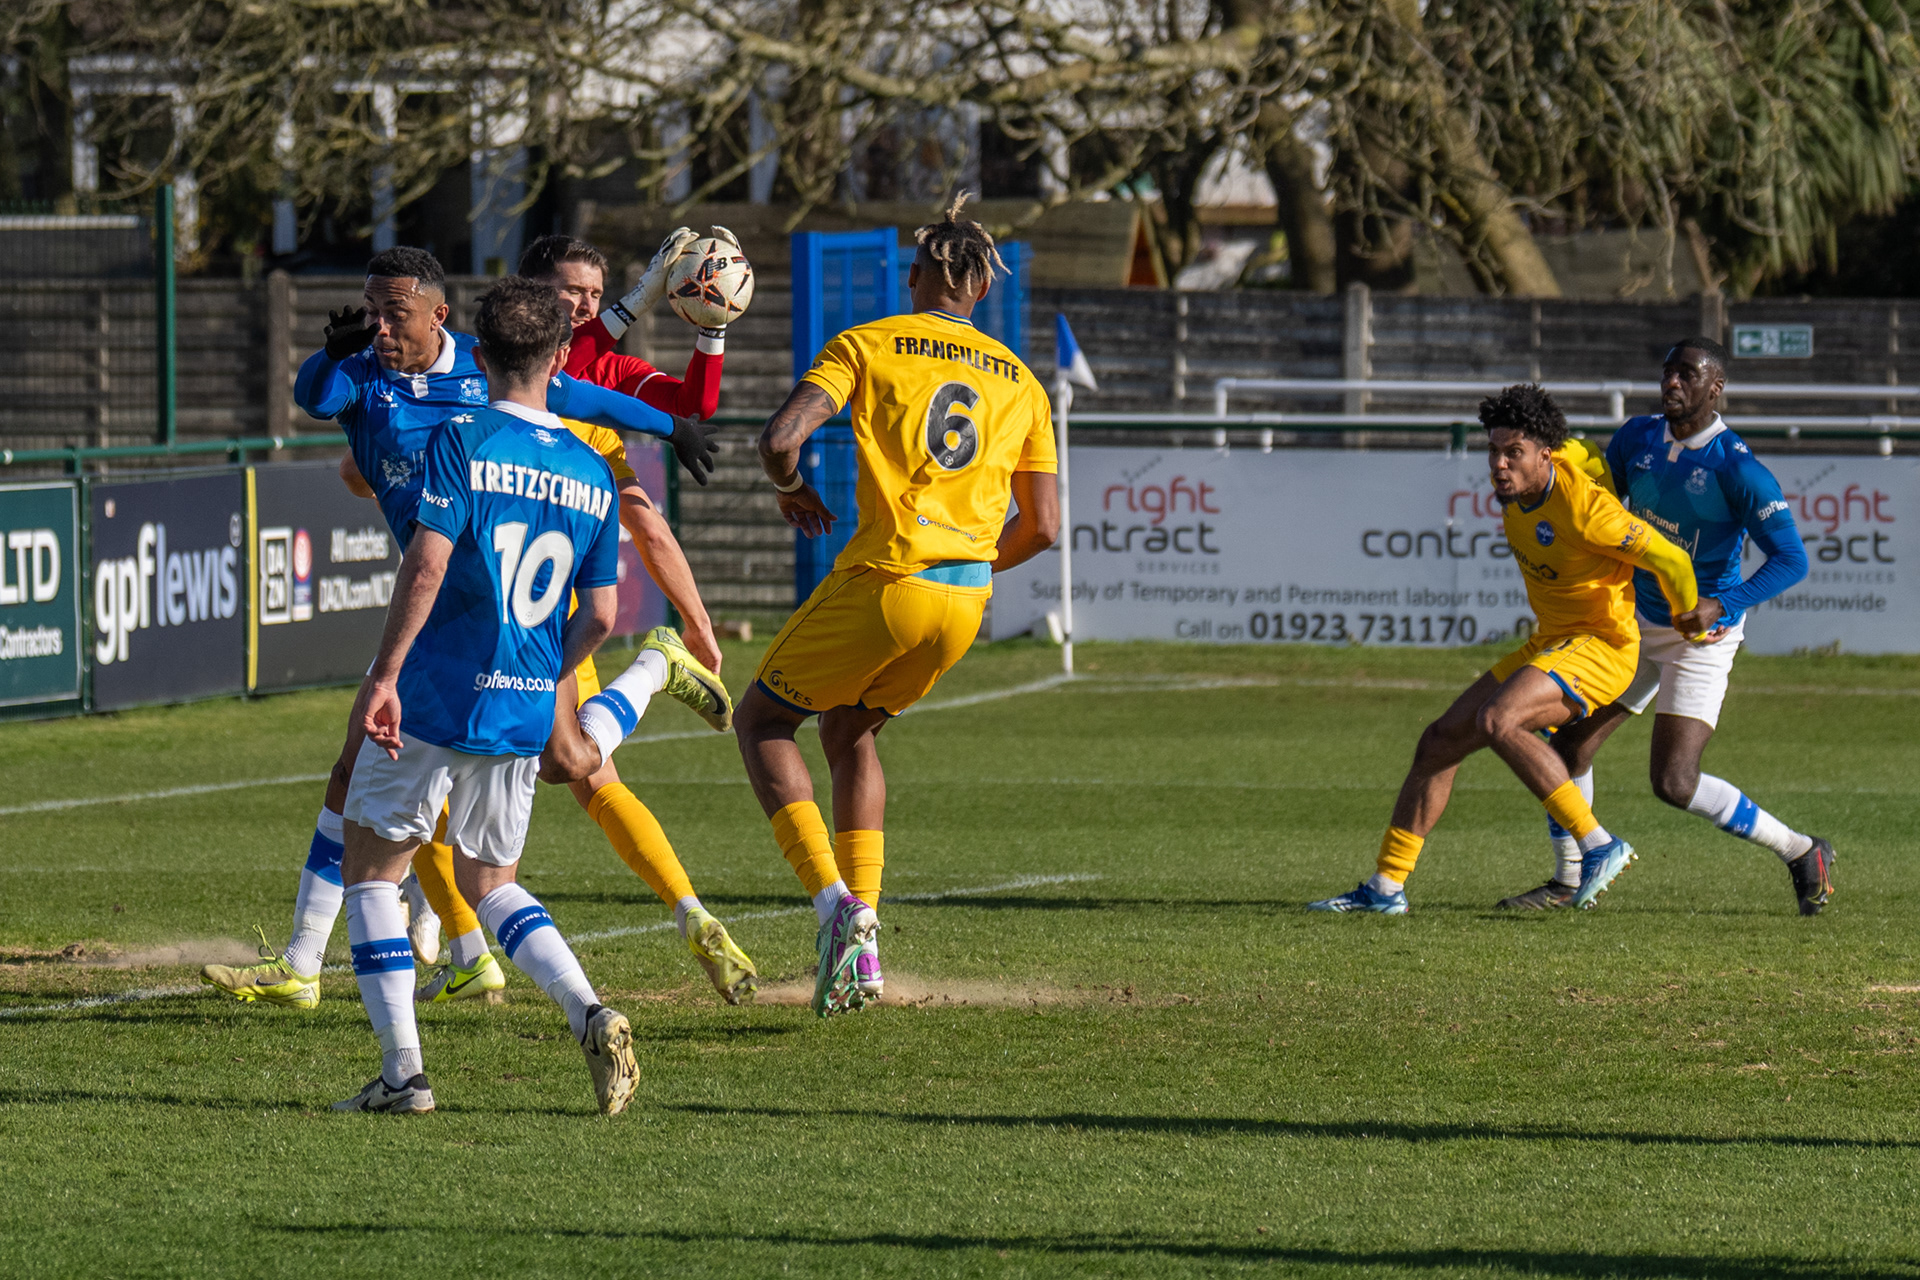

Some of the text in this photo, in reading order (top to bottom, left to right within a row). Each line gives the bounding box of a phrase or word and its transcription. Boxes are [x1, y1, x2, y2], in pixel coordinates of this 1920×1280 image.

[894, 336, 1020, 384] FRANCILLETTE
[926, 380, 980, 471] 6
[1103, 475, 1221, 526] right
[1448, 489, 1505, 531] rig
[1050, 519, 1221, 554] ntract
[1645, 508, 1680, 535] Brunel
[1362, 526, 1513, 558] contra
[0, 528, 61, 605] LTD
[494, 521, 574, 629] 10
[1136, 561, 1220, 574] SERVICES
[1809, 571, 1895, 583] SERVICES
[95, 521, 238, 666] gpflewis
[1103, 581, 1124, 600] of
[1130, 581, 1238, 606] Temporary
[1244, 583, 1282, 603] and
[1288, 585, 1400, 606] Permanent
[1406, 587, 1471, 607] labour
[1477, 589, 1500, 607] to
[1504, 588, 1529, 608] th
[1769, 593, 1887, 612] Nationwide
[0, 624, 62, 660] Contractors
[1175, 620, 1212, 638] Call
[1217, 624, 1244, 639] on
[1250, 612, 1347, 642] 01923
[1358, 614, 1477, 643] 731170
